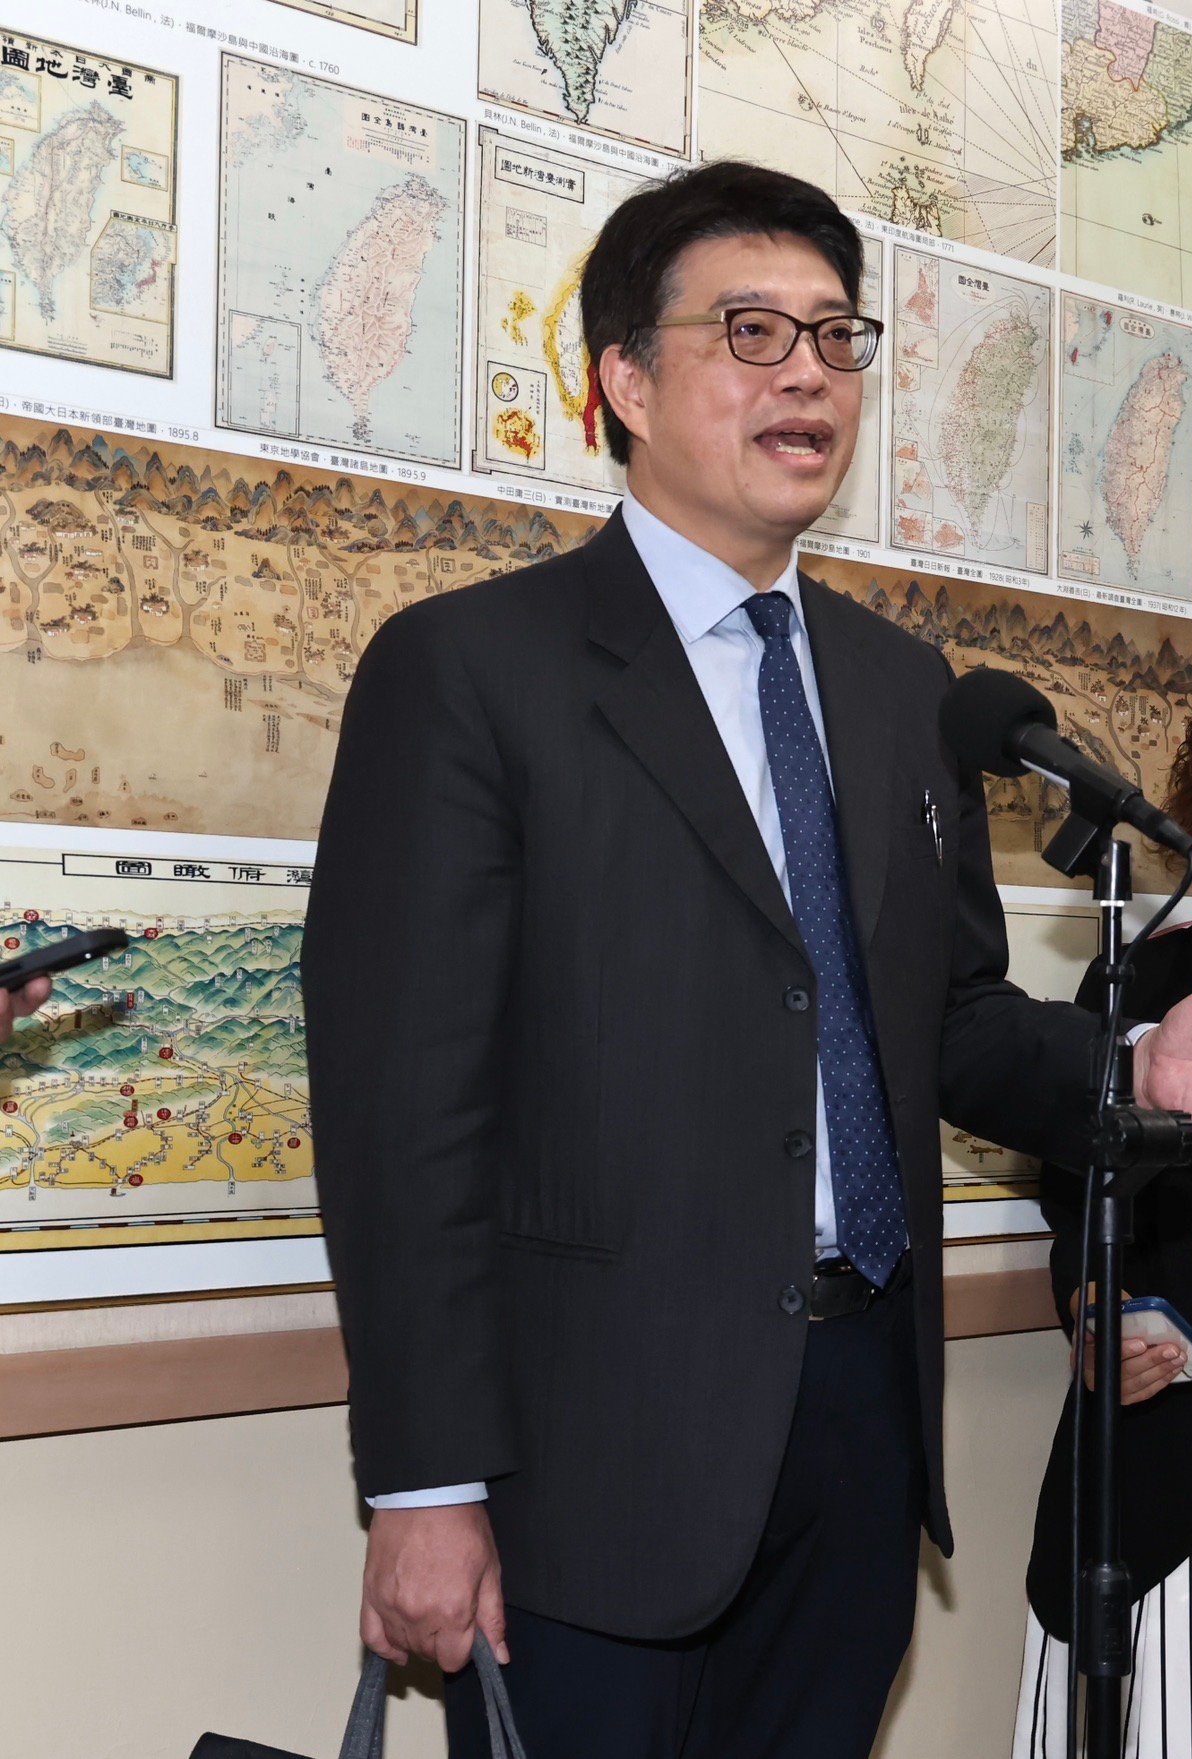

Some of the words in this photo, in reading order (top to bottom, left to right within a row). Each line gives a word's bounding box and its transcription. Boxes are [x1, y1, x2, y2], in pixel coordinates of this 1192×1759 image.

[319, 61, 340, 75] 1760
[22, 401, 157, 434] 帝國大日本新領部臺灣地圖
[168, 427, 199, 441] 1895.8
[260, 443, 320, 463] 東京地學協會
[330, 455, 388, 475] 臺灣諸島地圖
[857, 548, 871, 559] 1901
